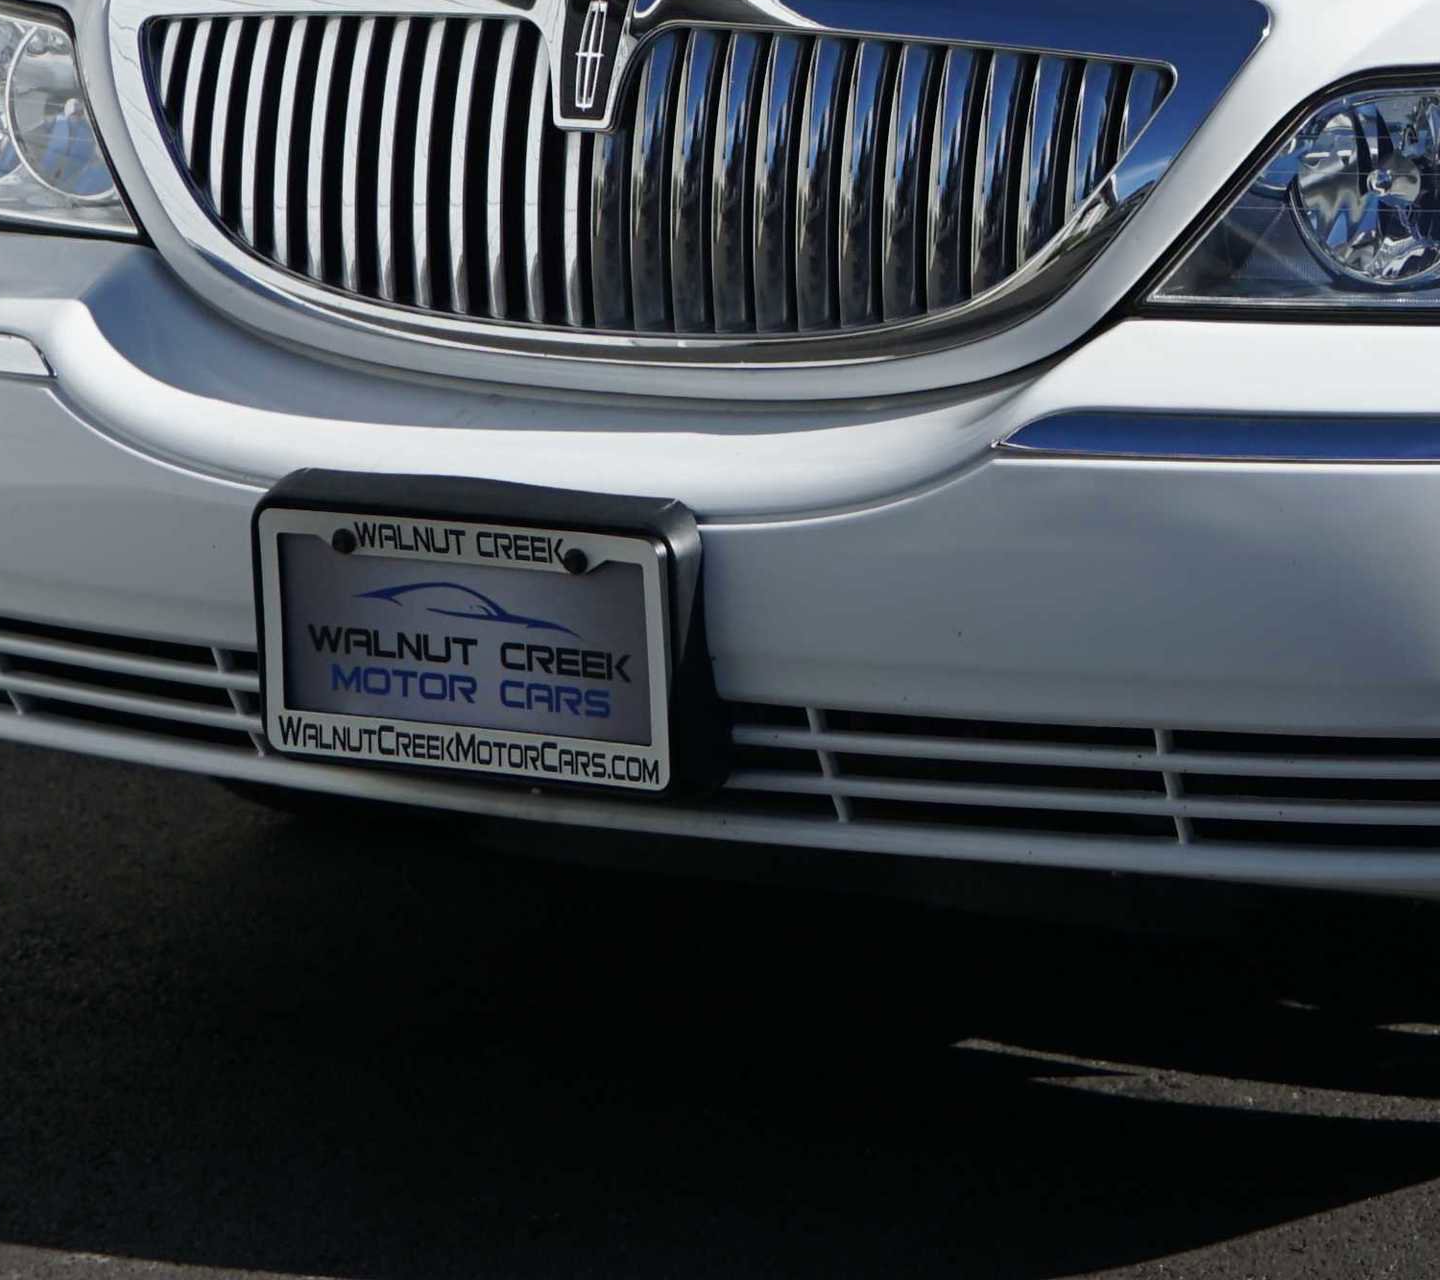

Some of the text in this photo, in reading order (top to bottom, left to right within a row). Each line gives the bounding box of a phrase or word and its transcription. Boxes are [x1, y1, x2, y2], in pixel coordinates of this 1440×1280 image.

[354, 521, 565, 564] WALNUT CREEK
[308, 624, 633, 684] WALNUT CREEK
[330, 663, 612, 719] MOTOR CARS
